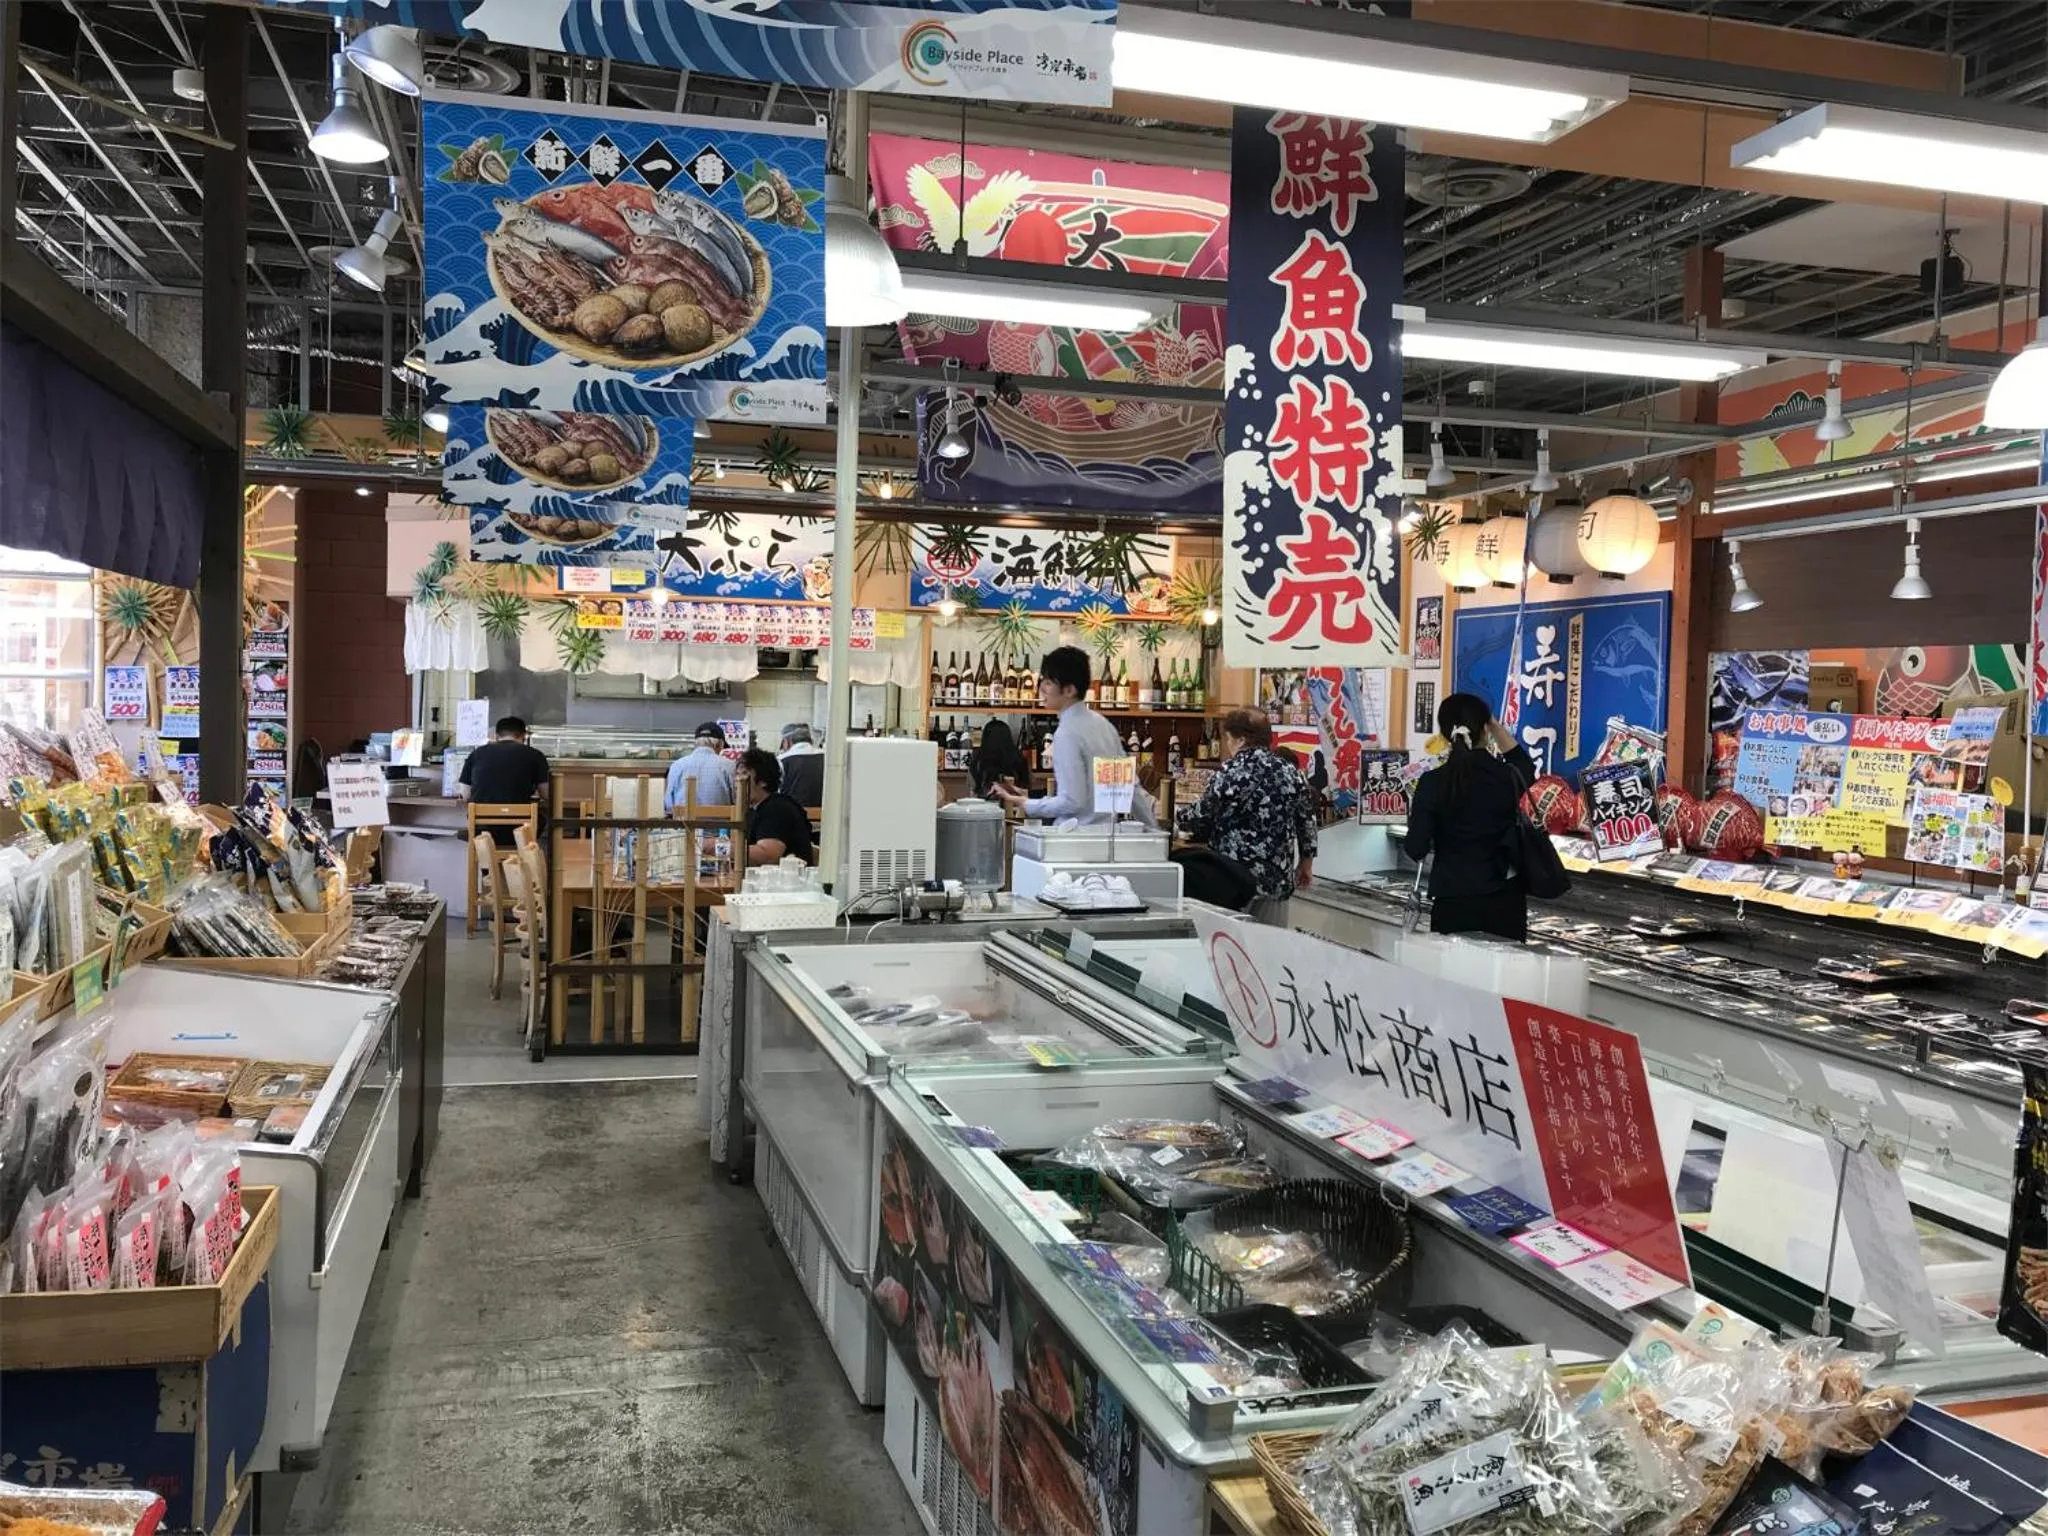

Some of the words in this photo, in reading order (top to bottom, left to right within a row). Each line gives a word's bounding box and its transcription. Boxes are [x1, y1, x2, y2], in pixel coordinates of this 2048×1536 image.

[927, 46, 982, 66] Bayside
[987, 50, 1024, 65] Place
[534, 138, 725, 185] 新鮮一番
[1265, 109, 1378, 648] 鮮魚特売
[110, 703, 140, 714] 500
[1520, 624, 1566, 780] 寿司
[1749, 711, 1809, 735] お食事処
[1853, 718, 1931, 742] 寿司バイキング
[1366, 791, 1403, 815] 100
[1592, 796, 1655, 822] バイキング
[1600, 812, 1653, 848] 100
[1276, 965, 1522, 1151] 永松商店
